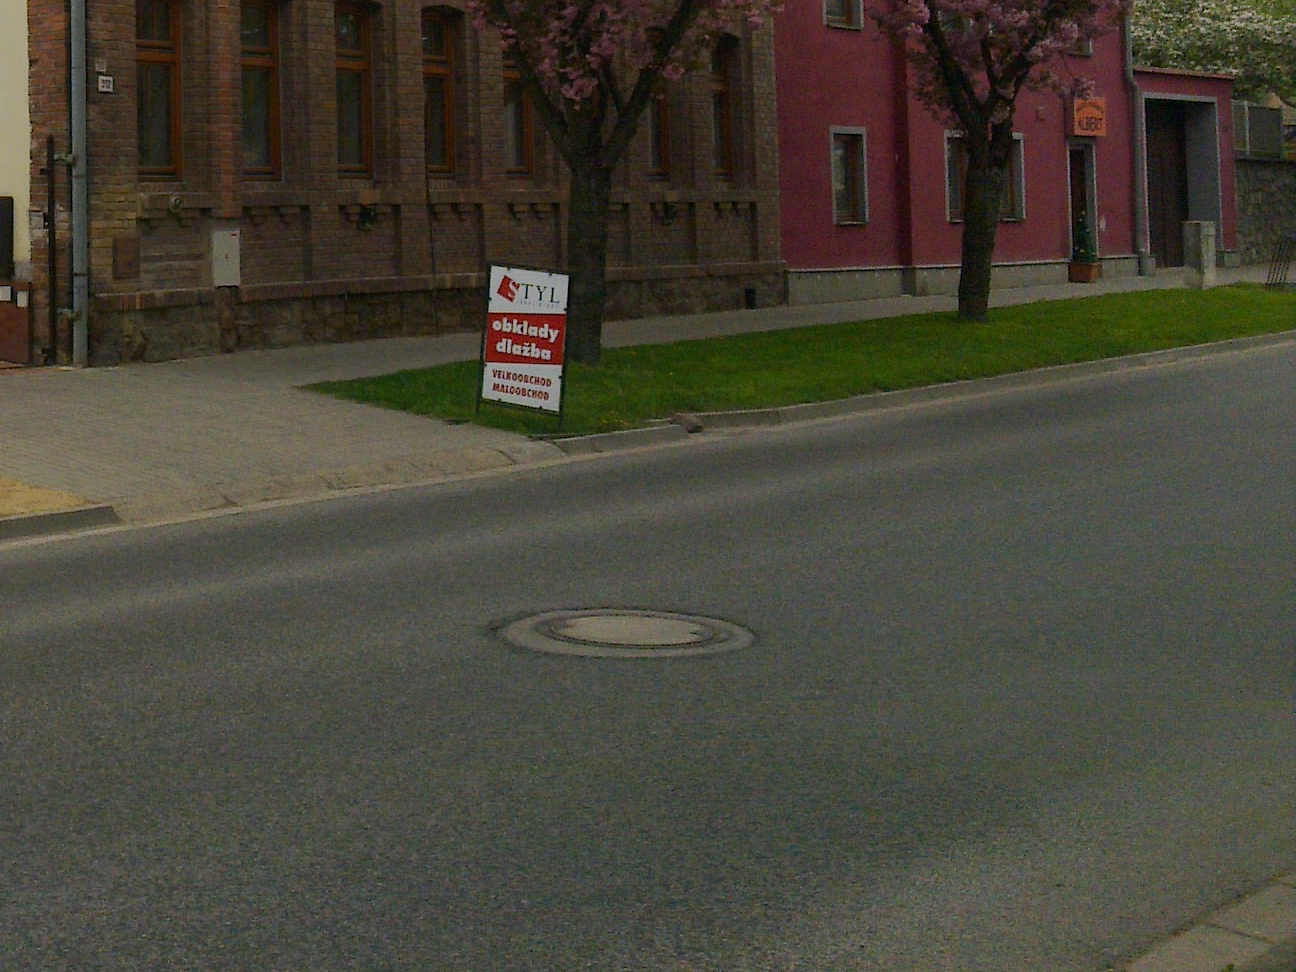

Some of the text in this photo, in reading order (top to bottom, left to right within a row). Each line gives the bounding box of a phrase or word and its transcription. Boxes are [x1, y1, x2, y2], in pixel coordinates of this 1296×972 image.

[506, 279, 560, 304] STYL
[492, 317, 560, 343] obklady
[495, 339, 552, 361] dlažba
[492, 369, 552, 388] VELKOOBCHOD
[492, 383, 550, 401] MALOOBCHOD
